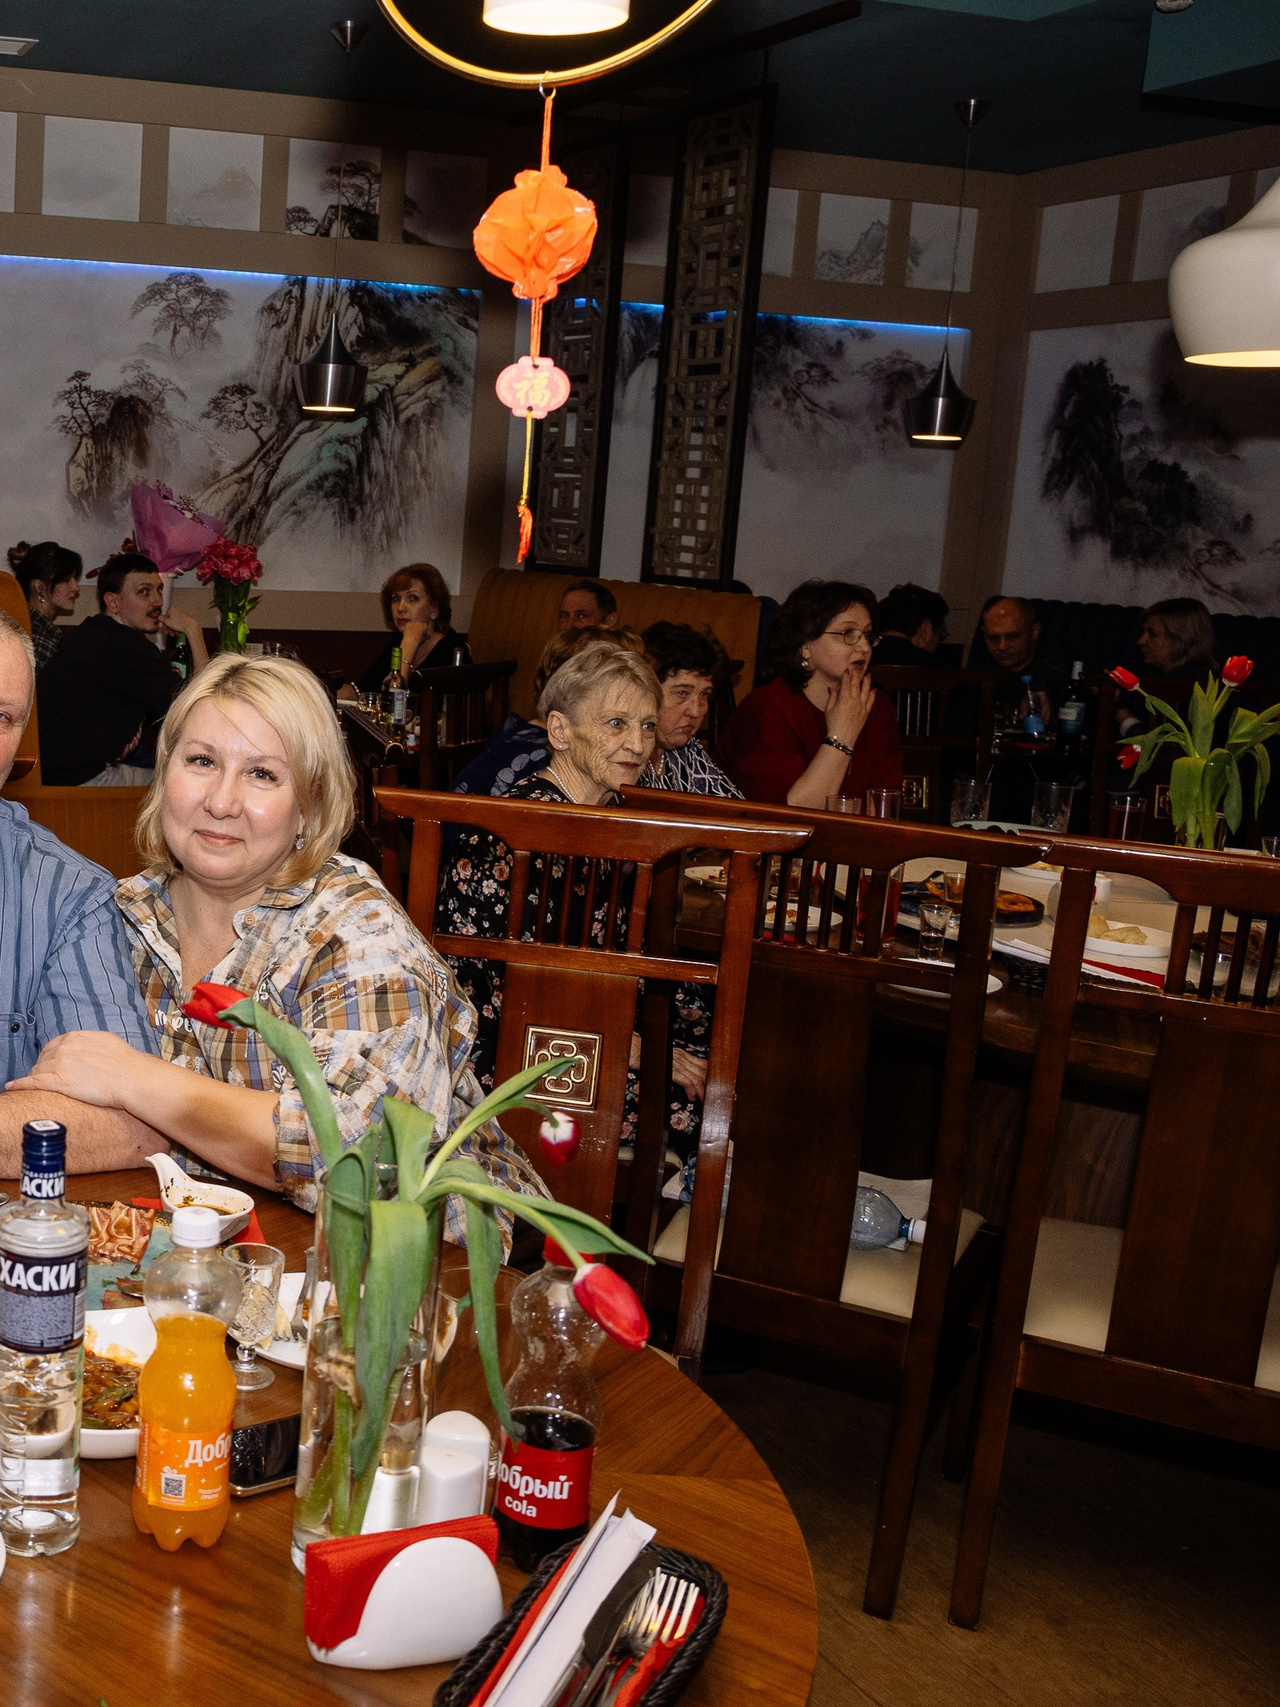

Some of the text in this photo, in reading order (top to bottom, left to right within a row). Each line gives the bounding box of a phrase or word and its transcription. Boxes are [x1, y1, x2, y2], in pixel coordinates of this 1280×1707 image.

[513, 370, 551, 407] 福
[21, 1175, 65, 1198] АСКИ
[0, 1256, 76, 1292] ХАСКИ
[500, 1463, 570, 1500] обрый
[504, 1495, 537, 1518] cola
